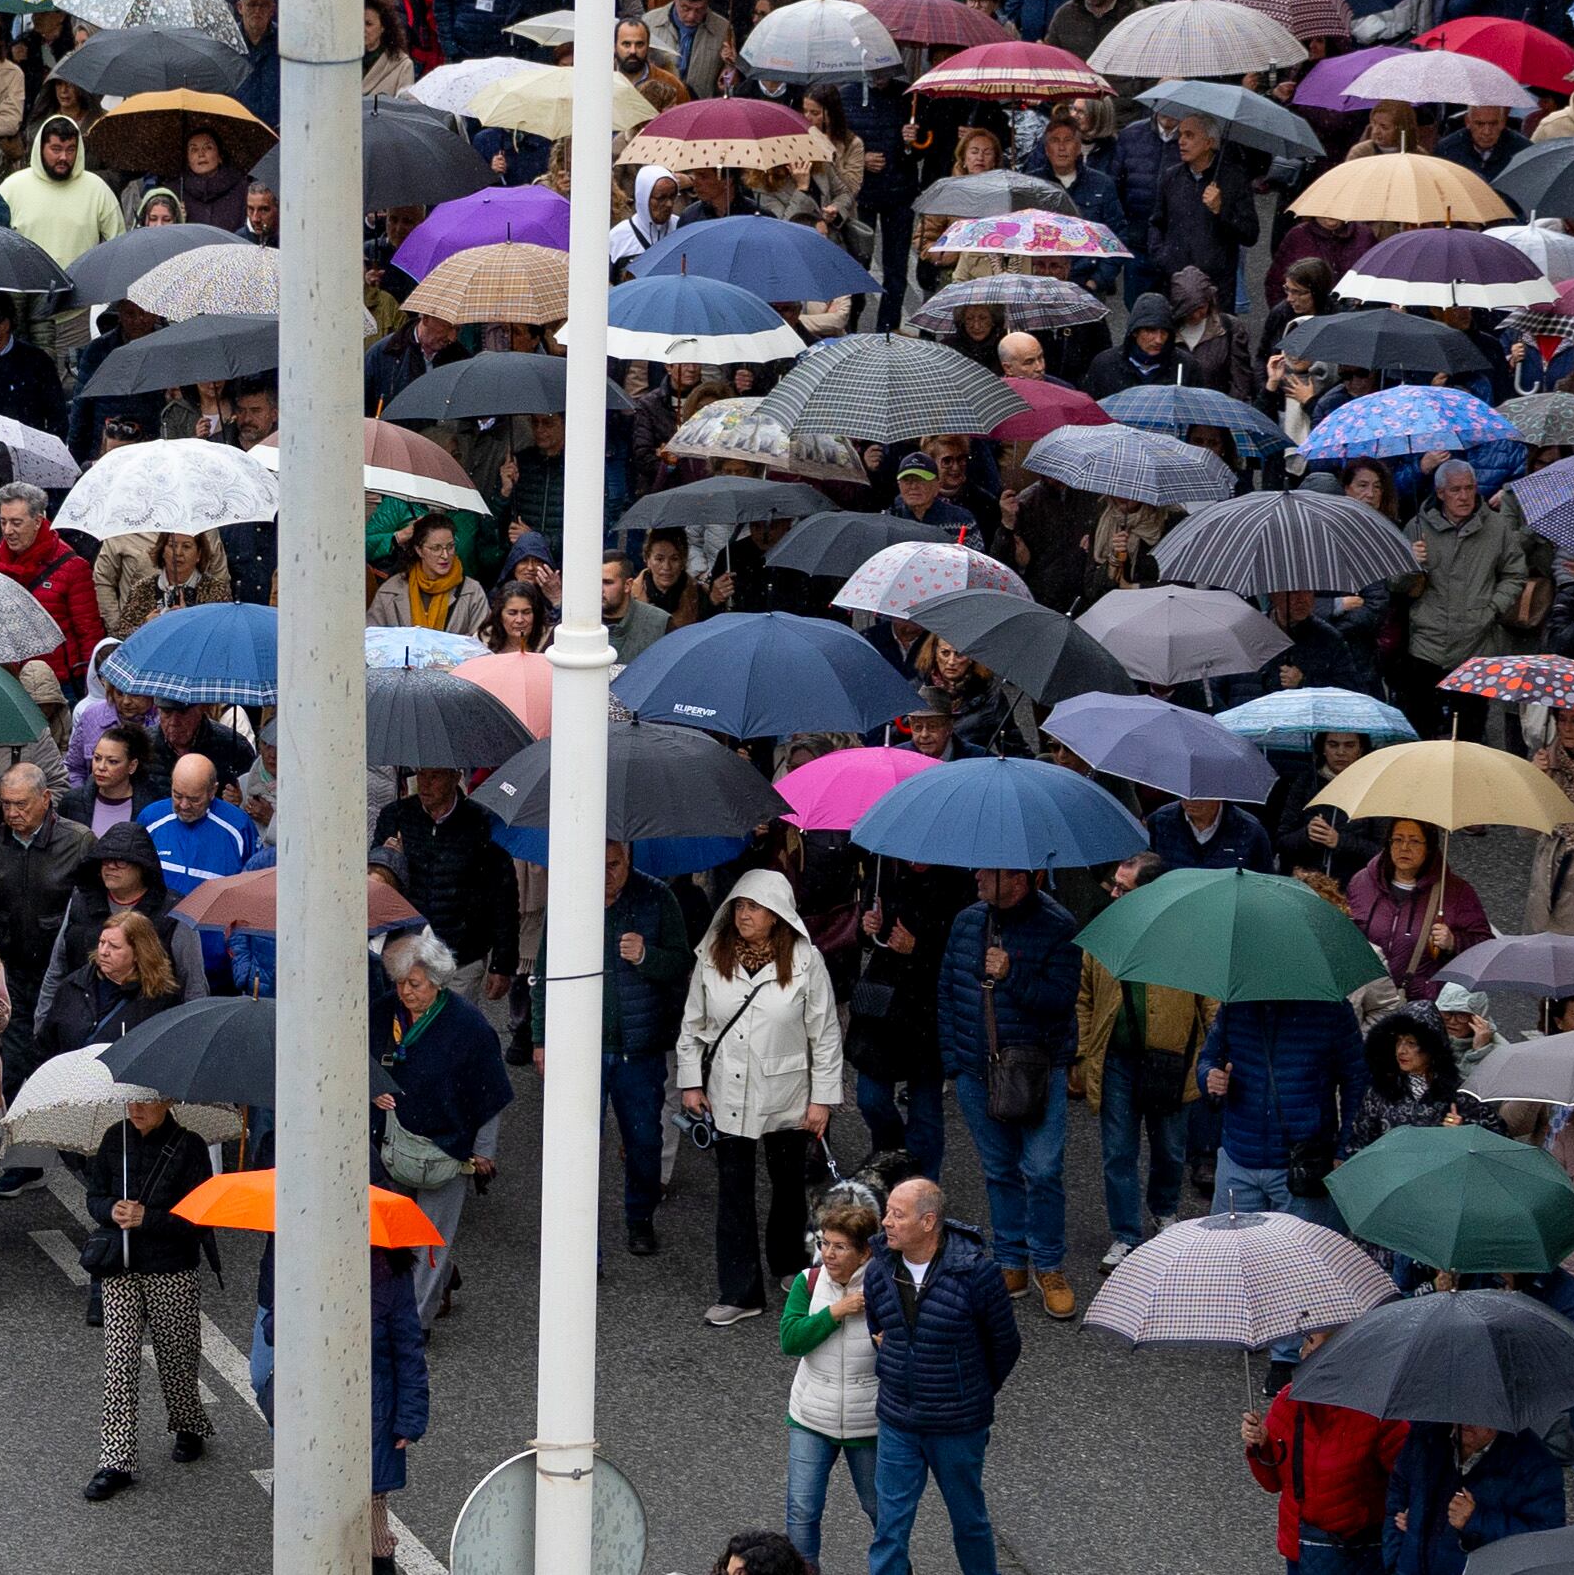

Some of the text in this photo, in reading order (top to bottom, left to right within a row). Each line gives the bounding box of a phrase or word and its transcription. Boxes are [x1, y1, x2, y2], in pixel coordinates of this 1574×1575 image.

[816, 61, 821, 69] 7
[821, 61, 838, 69] Days
[673, 703, 717, 717] KLIPERVIP
